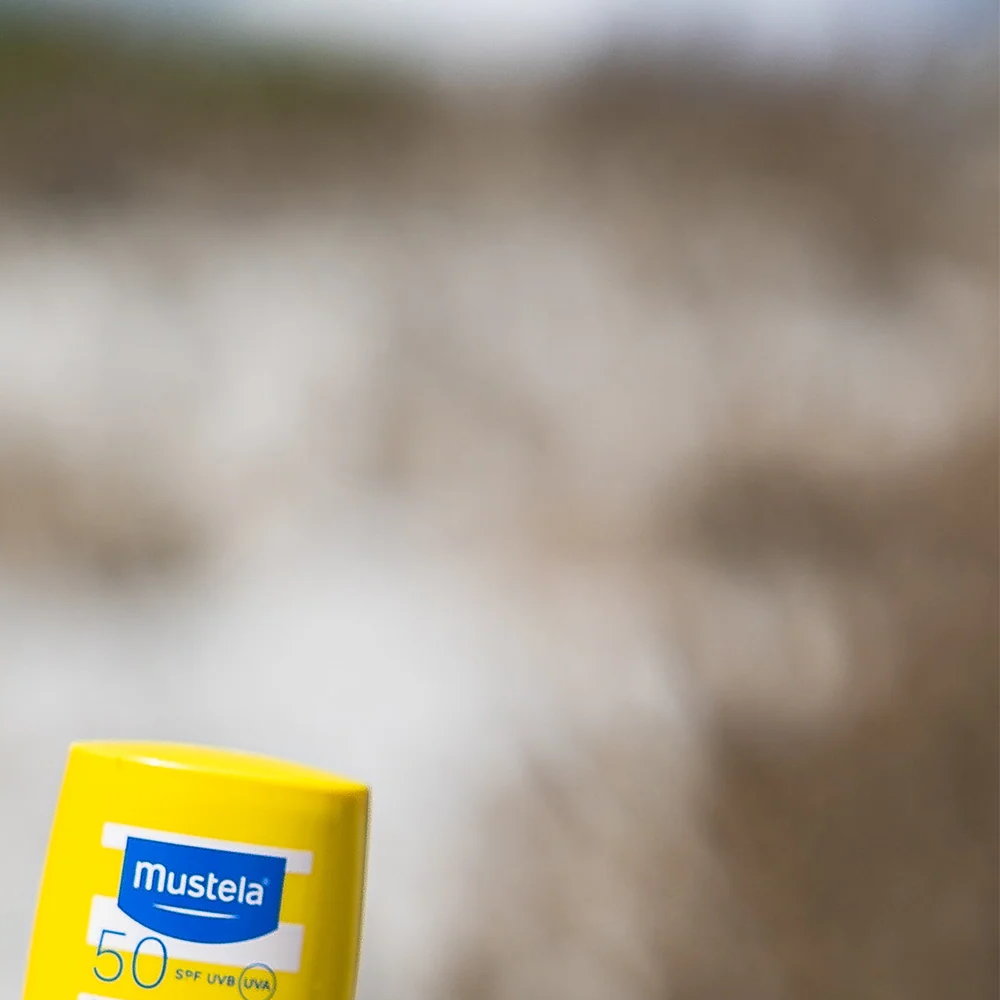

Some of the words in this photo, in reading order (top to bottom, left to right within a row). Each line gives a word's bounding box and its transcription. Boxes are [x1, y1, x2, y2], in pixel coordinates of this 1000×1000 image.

[93, 929, 168, 989] 50
[207, 973, 235, 987] UVB
[243, 977, 271, 991] UVA
